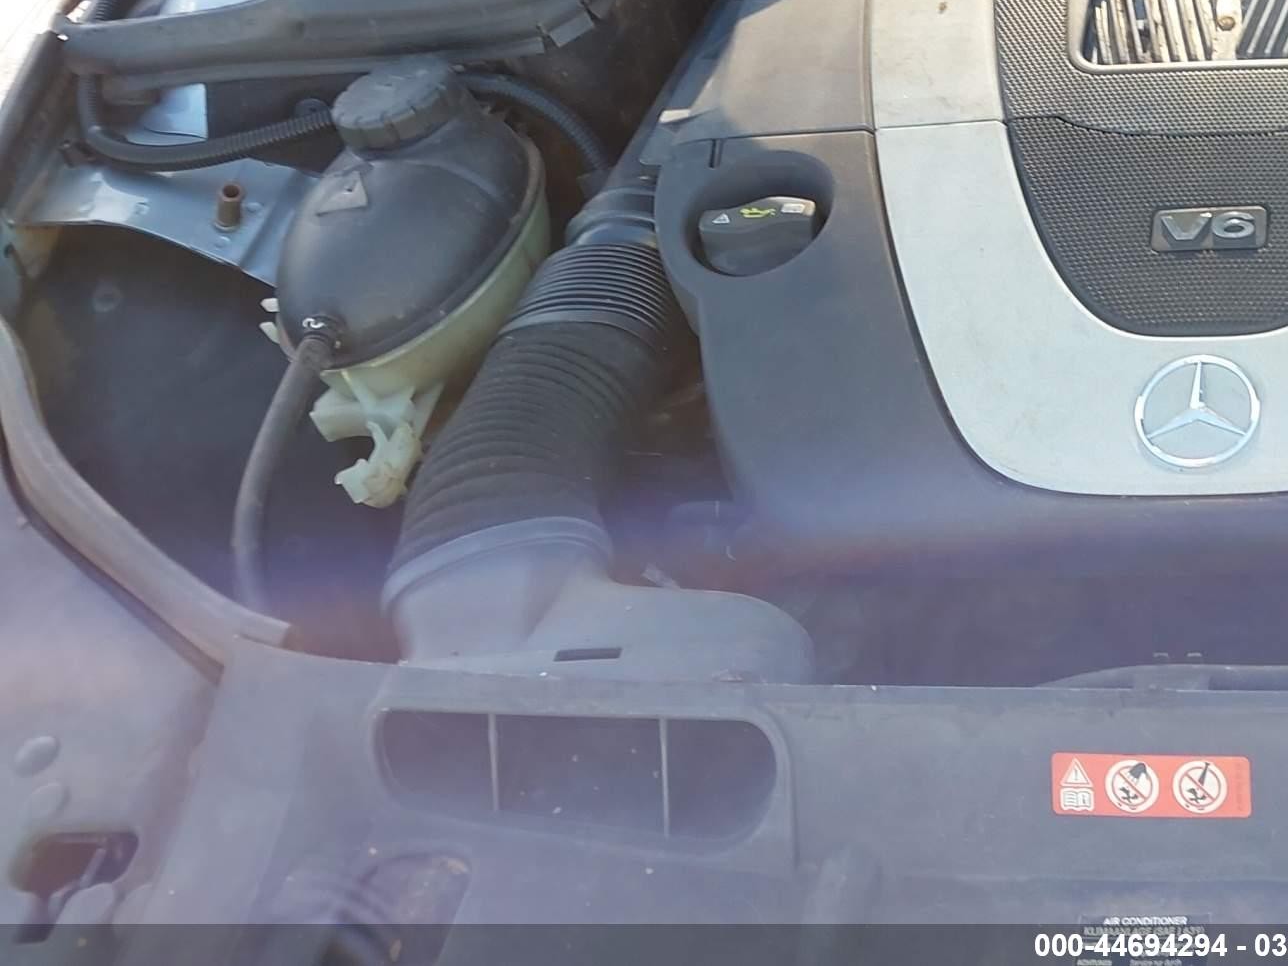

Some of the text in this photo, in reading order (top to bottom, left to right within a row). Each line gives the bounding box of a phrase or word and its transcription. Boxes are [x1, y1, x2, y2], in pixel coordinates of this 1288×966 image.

[1160, 211, 1255, 240] V6
[1103, 916, 1188, 925] AIR CONDITIONER
